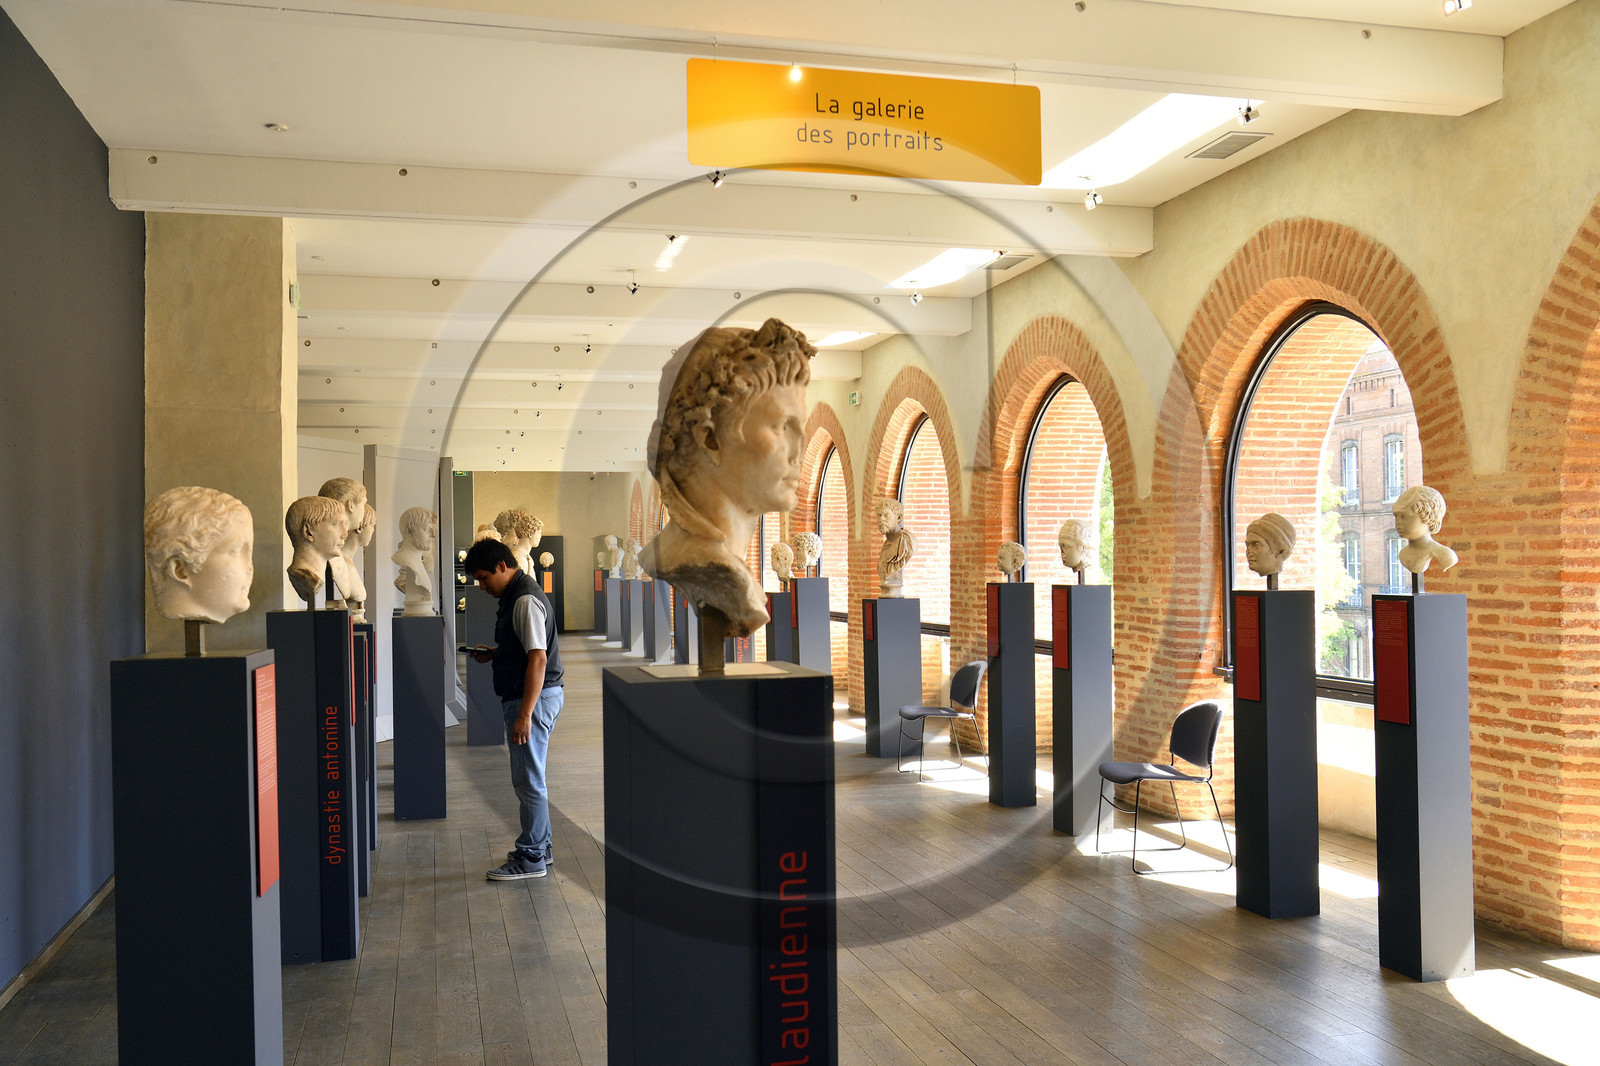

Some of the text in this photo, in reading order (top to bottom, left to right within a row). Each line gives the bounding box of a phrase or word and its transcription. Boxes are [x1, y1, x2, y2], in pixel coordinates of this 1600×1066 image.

[815, 92, 925, 121] La galerie
[796, 122, 944, 151] des portraits
[321, 705, 346, 865] dynastie antonine
